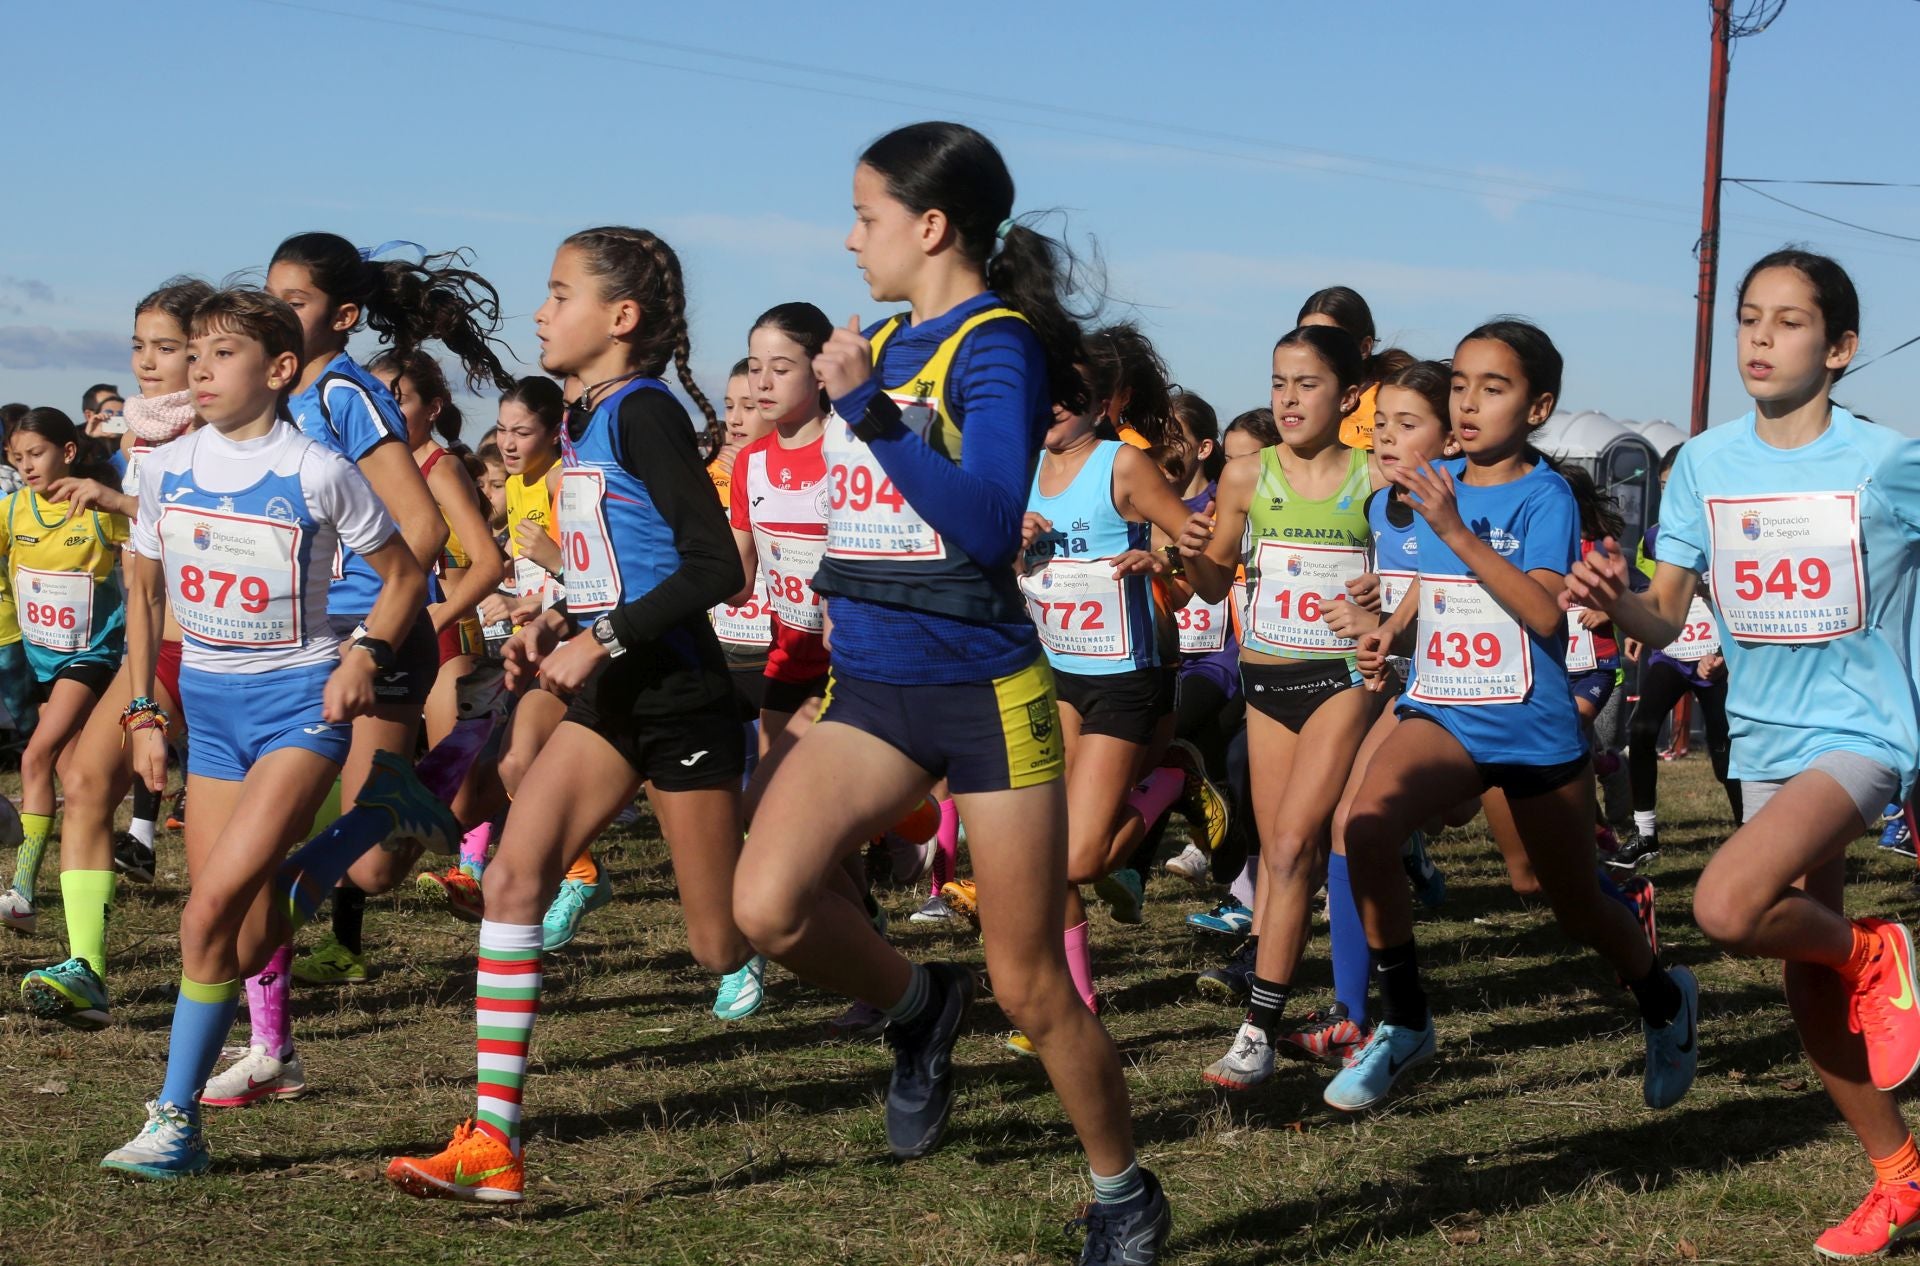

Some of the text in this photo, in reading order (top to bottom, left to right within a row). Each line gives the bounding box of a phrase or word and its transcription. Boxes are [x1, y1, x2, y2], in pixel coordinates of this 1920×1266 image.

[830, 464, 905, 513] 394
[1762, 515, 1810, 528] Diputación
[855, 523, 905, 534] NACIONAL
[908, 524, 923, 534] DE
[1262, 528, 1344, 539] LA GRANJA
[212, 531, 256, 546] Diputación
[1763, 528, 1810, 541] de Segovia
[225, 545, 256, 557] Segovia
[782, 547, 814, 558] Diputación
[792, 556, 815, 565] Segovia
[1303, 561, 1339, 572] Diputación
[1054, 572, 1088, 583] Diputación
[1313, 571, 1338, 580] Segovia
[1735, 557, 1831, 601] 549
[597, 579, 608, 588] DE
[1063, 581, 1089, 590] Segovia
[180, 565, 270, 614] 879
[587, 592, 608, 602] 2025
[1447, 595, 1481, 605] Diputación
[27, 602, 76, 629] 896
[1034, 599, 1105, 630] 772
[1456, 606, 1482, 616] Segovia
[1728, 606, 1849, 620] LIII CROSS NACIONAL DE
[188, 610, 214, 624] CROSS
[216, 617, 268, 629] NACIONAL
[271, 621, 284, 629] DE
[177, 614, 282, 640] CANTIMPALOS 2025
[1262, 621, 1334, 637] LIII CROSS NACION
[1735, 619, 1847, 633] CANTIMPALOS 2025
[719, 628, 765, 639] CANTIMPALOS
[1263, 631, 1326, 646] CANTIMPALOS
[1064, 635, 1104, 644] NACIONAL
[1093, 644, 1114, 653] 2025
[1426, 631, 1502, 668] 439
[1431, 675, 1453, 684] CROSS
[1455, 676, 1502, 684] NACIONAL
[1504, 674, 1517, 683] DE
[1423, 685, 1481, 696] CANTIMPALOS
